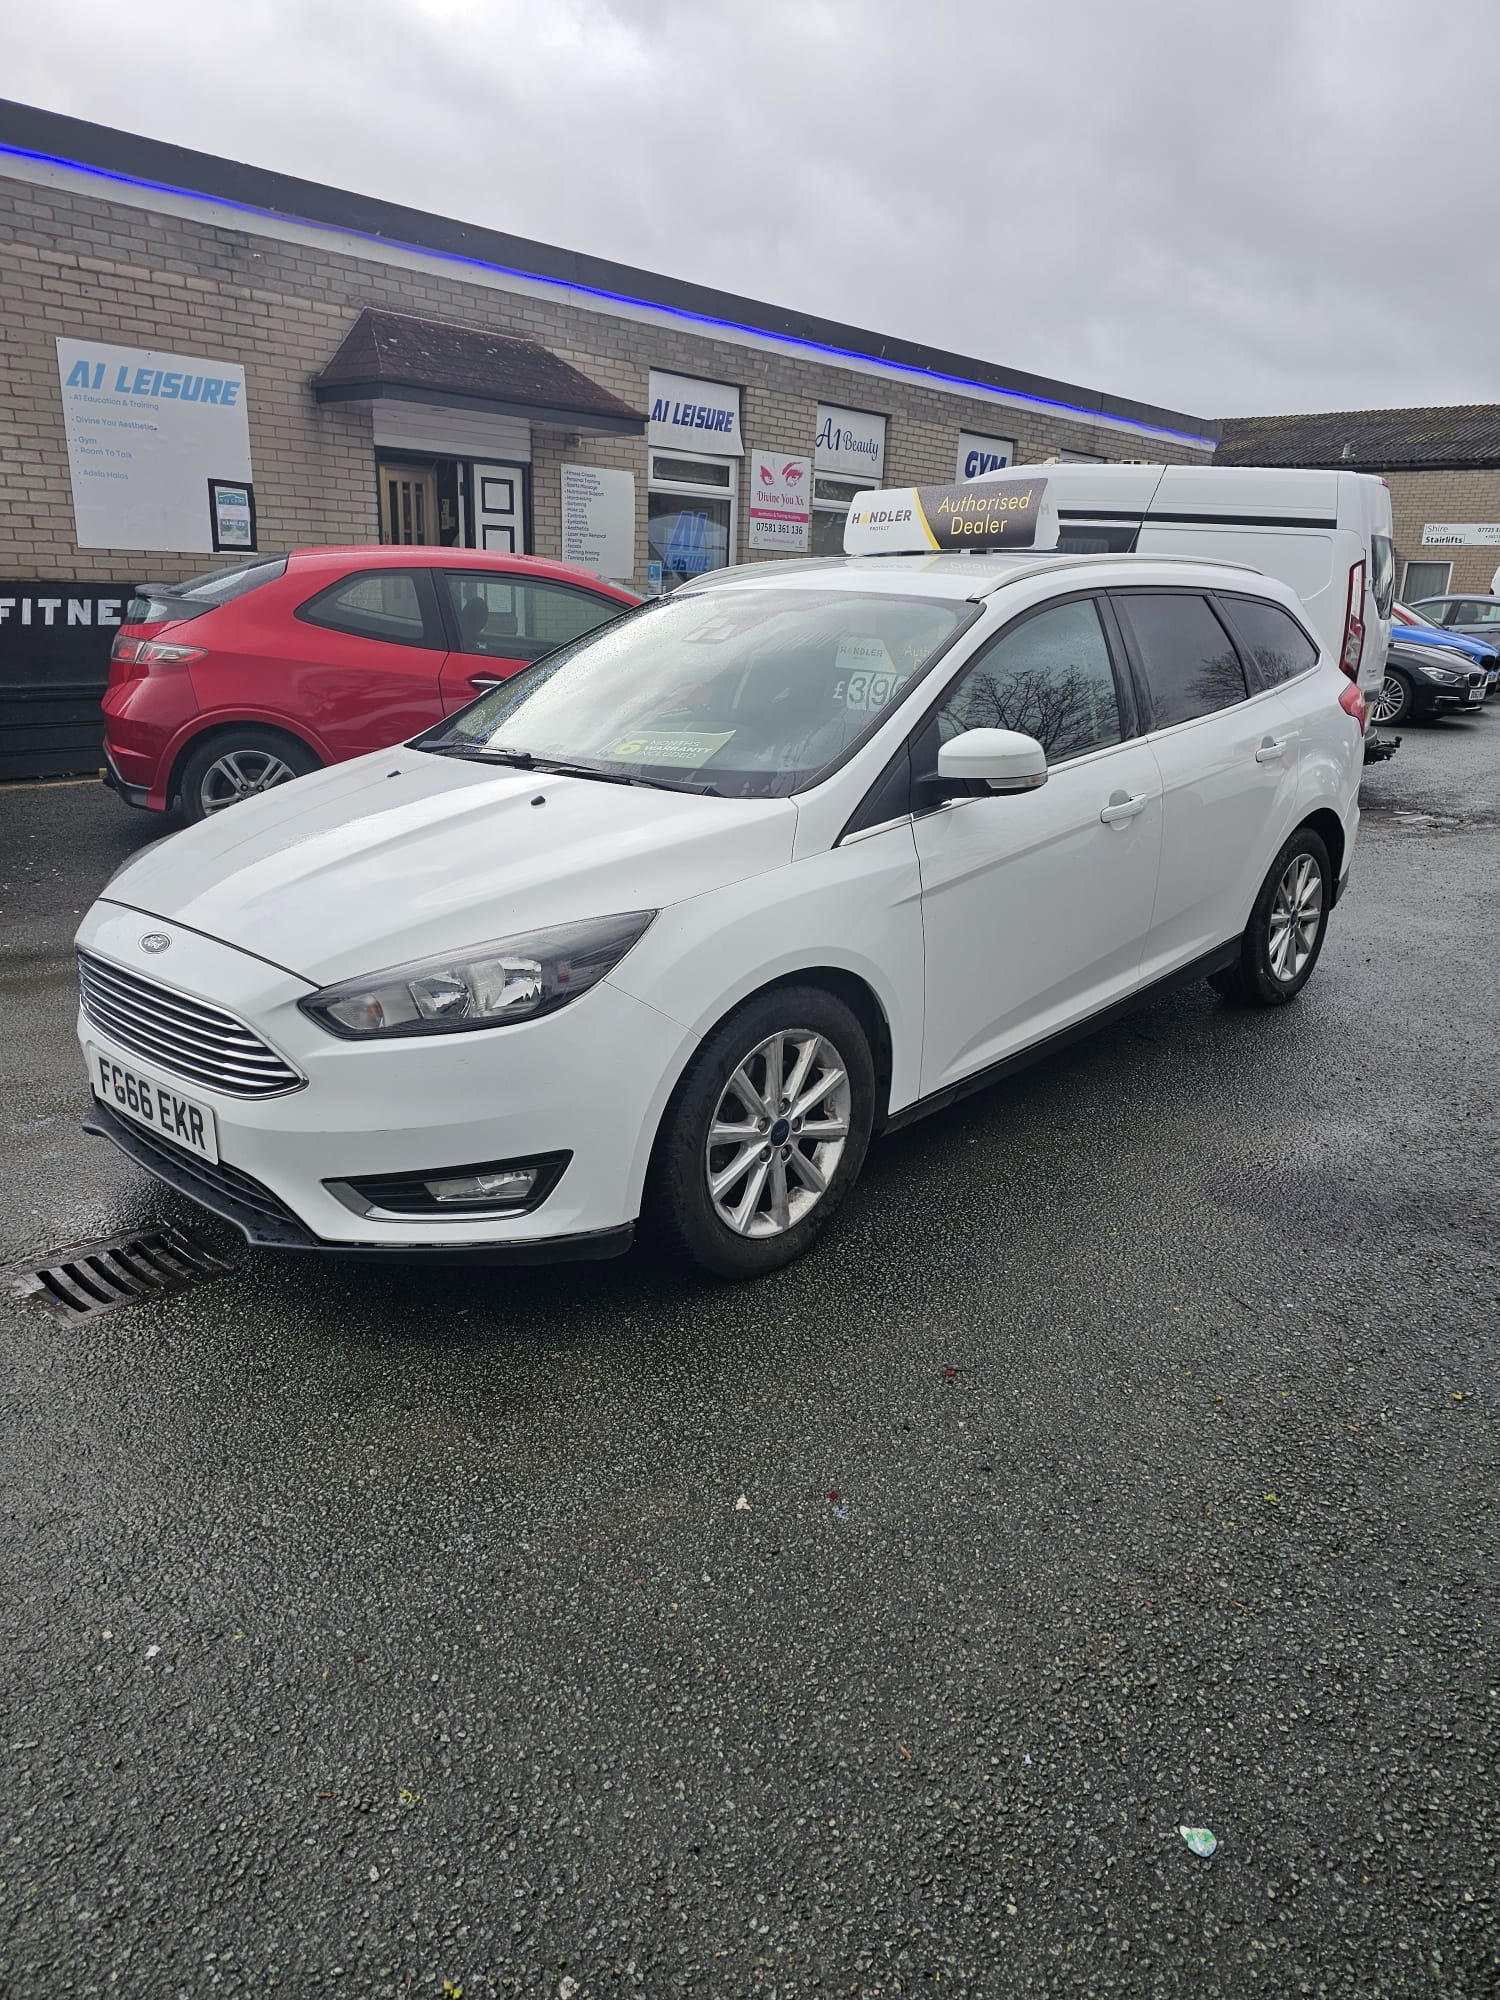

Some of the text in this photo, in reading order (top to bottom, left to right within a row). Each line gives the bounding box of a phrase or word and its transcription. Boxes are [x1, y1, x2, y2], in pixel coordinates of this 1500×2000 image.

[114, 365, 241, 406] LEISURE
[84, 395, 121, 406] Education
[130, 401, 159, 411] Training
[75, 416, 100, 425] Divine
[102, 419, 117, 427] You
[672, 403, 735, 432] LEISURE
[78, 436, 97, 445] Gym
[816, 418, 879, 461] A1 Beauty
[80, 447, 132, 459] Room To Talk
[757, 491, 779, 503] Divine
[781, 494, 794, 507] You
[937, 490, 1033, 513] Authorised
[852, 510, 912, 524] HANDLER
[951, 514, 1008, 535] Dealer
[757, 523, 803, 534] 07581 361 136
[1427, 525, 1449, 533] Shire
[1425, 535, 1462, 543] Stairlifts
[0, 598, 134, 625] FITNE
[613, 740, 648, 755] 6
[645, 745, 712, 753] WARRANTY
[99, 1056, 206, 1150] FG66 EKR
